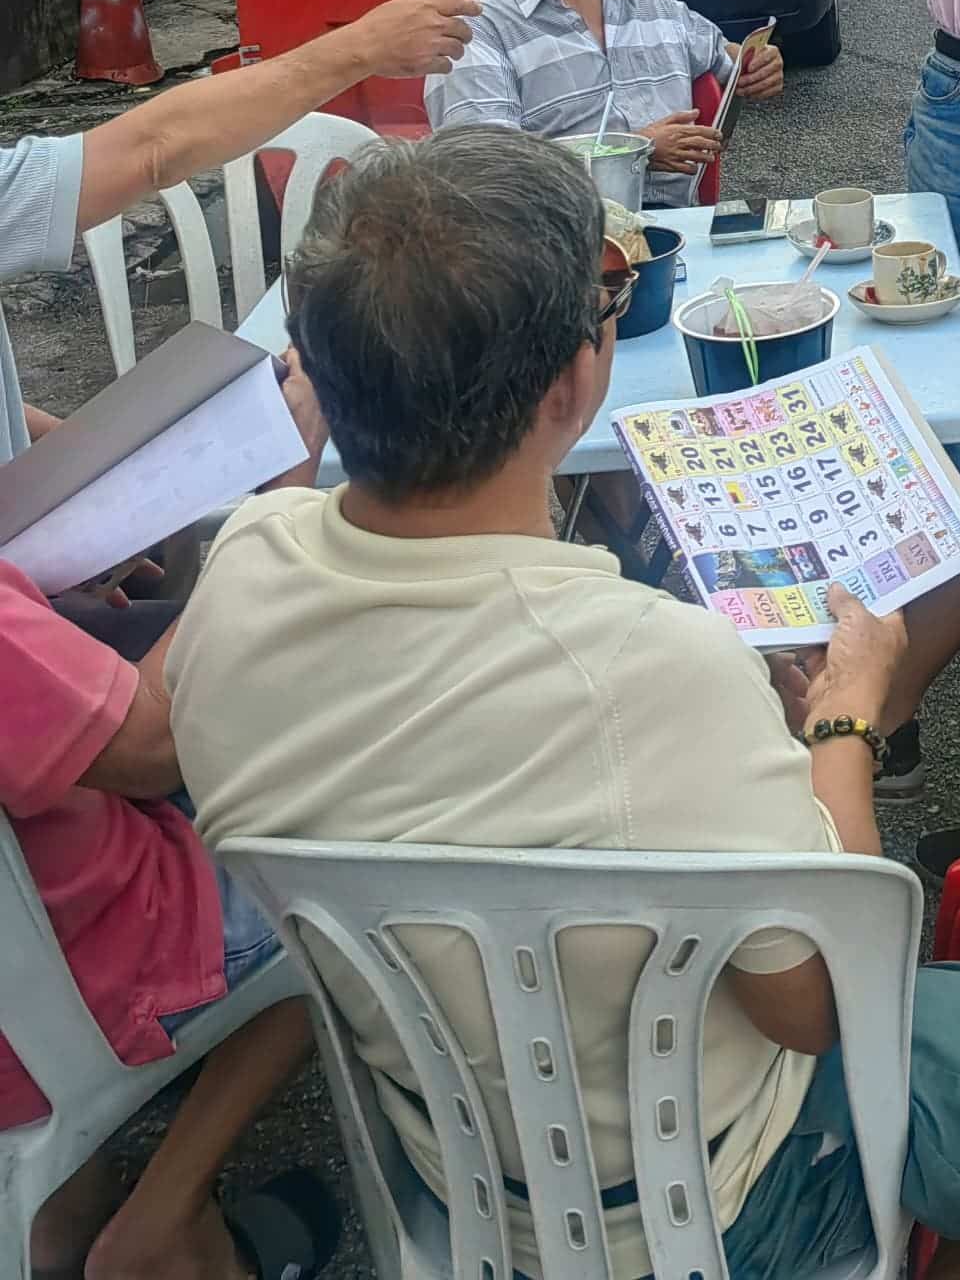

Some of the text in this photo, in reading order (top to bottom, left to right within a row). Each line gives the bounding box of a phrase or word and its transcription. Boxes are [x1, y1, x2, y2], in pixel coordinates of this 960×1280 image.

[783, 390, 807, 413] 31
[770, 432, 796, 458] 23
[800, 421, 827, 447] 24
[681, 447, 706, 471] 20
[710, 447, 736, 469] 21
[740, 439, 766, 465] 22
[787, 467, 812, 492] 16
[816, 458, 842, 481] 17
[698, 481, 722, 506] 13
[757, 476, 781, 501] 15
[836, 490, 861, 516] 10
[778, 518, 798, 532] 8
[809, 509, 829, 524] 9
[719, 524, 737, 537] 6
[747, 523, 767, 536] 7
[859, 530, 878, 546] 3
[828, 544, 849, 562] 2
[910, 543, 929, 566] SAT
[878, 560, 897, 583] FRI
[724, 597, 747, 626] SUN
[754, 592, 778, 627] MON
[785, 592, 805, 620] TUE
